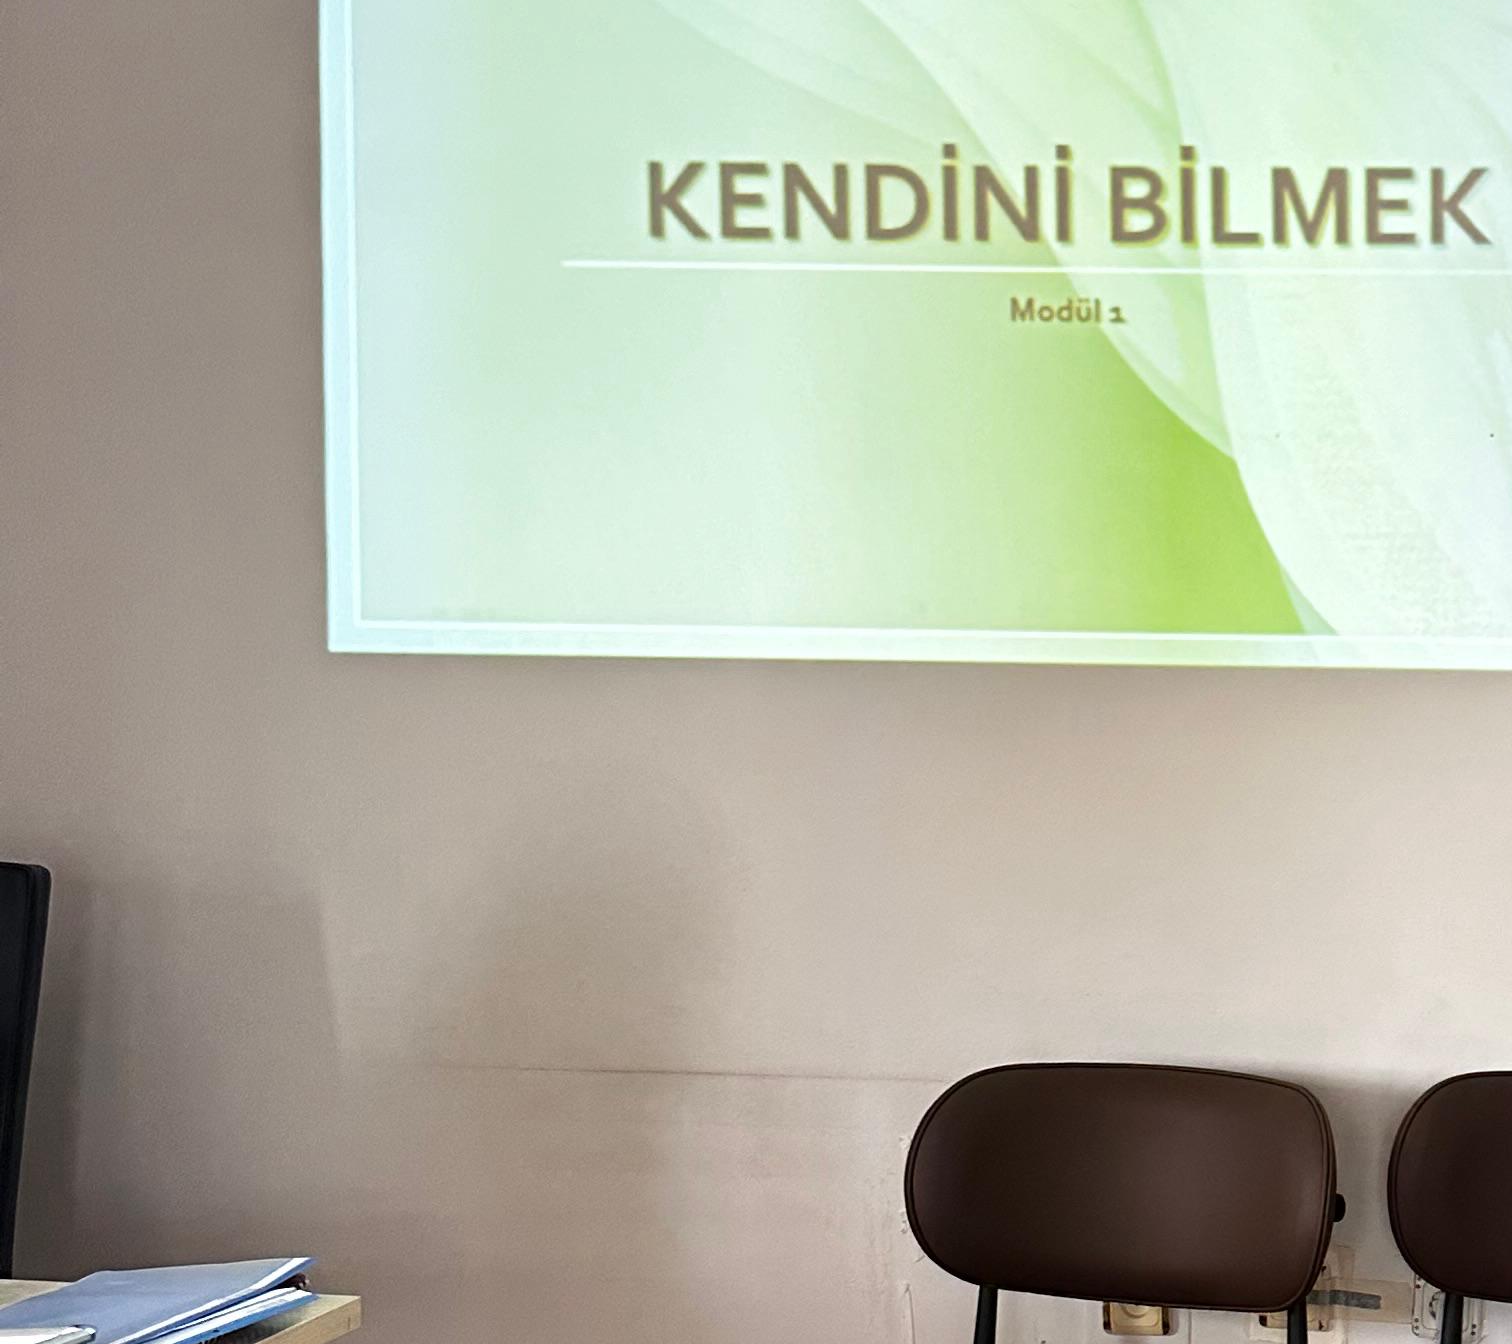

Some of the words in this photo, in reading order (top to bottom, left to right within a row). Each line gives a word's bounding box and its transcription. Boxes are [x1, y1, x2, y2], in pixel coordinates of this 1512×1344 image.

[646, 143, 1073, 244] KENDİNİ
[1108, 145, 1494, 248] BİLMEK
[1009, 297, 1102, 325] Modül
